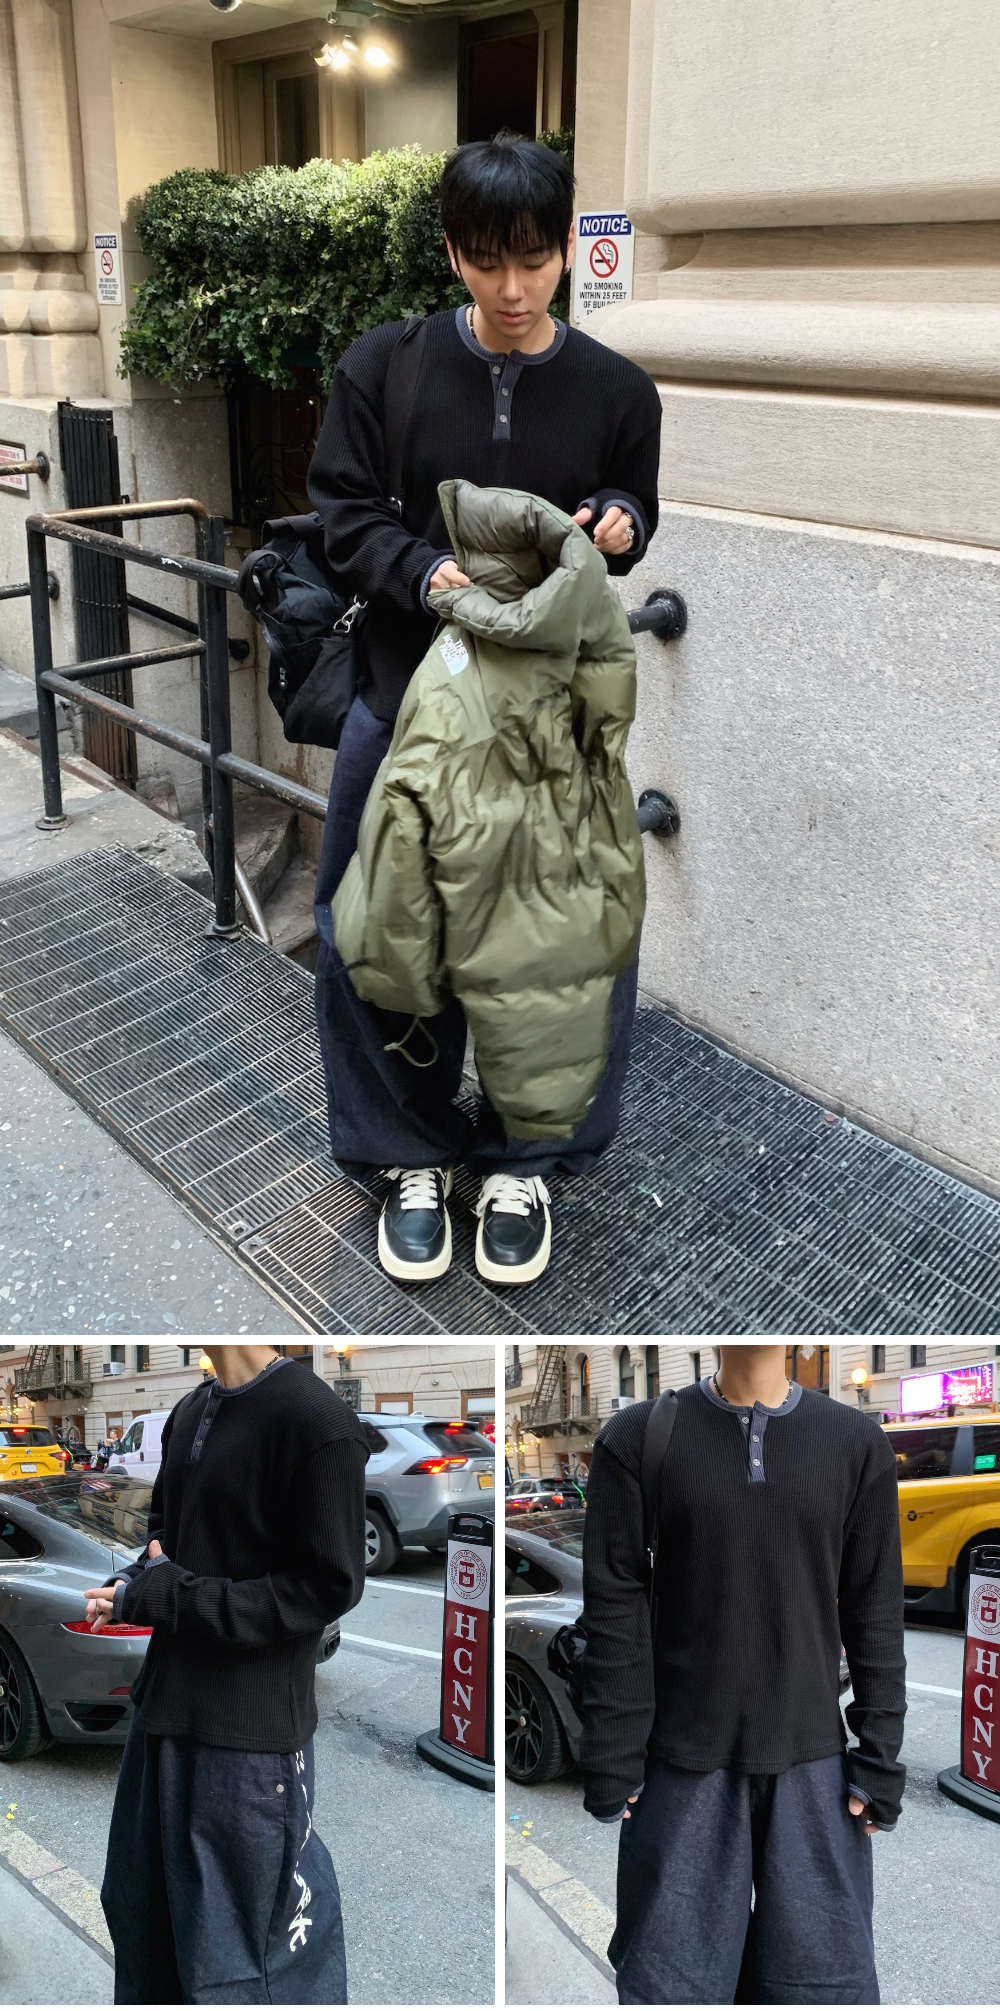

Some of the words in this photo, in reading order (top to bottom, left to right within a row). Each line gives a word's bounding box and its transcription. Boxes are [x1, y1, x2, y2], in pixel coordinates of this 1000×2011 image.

[581, 217, 629, 233] NOTICE
[95, 237, 116, 247] NOTICE
[583, 282, 593, 290] NO
[593, 282, 623, 290] SMOKING
[579, 291, 601, 300] WITHIN
[602, 291, 611, 300] 25
[612, 291, 627, 300] FEET
[583, 300, 592, 309] OF
[442, 633, 460, 660] NORTH
[454, 637, 467, 656] THE
[452, 1611, 477, 1744] HCNY
[972, 1647, 999, 1780] HCNY
